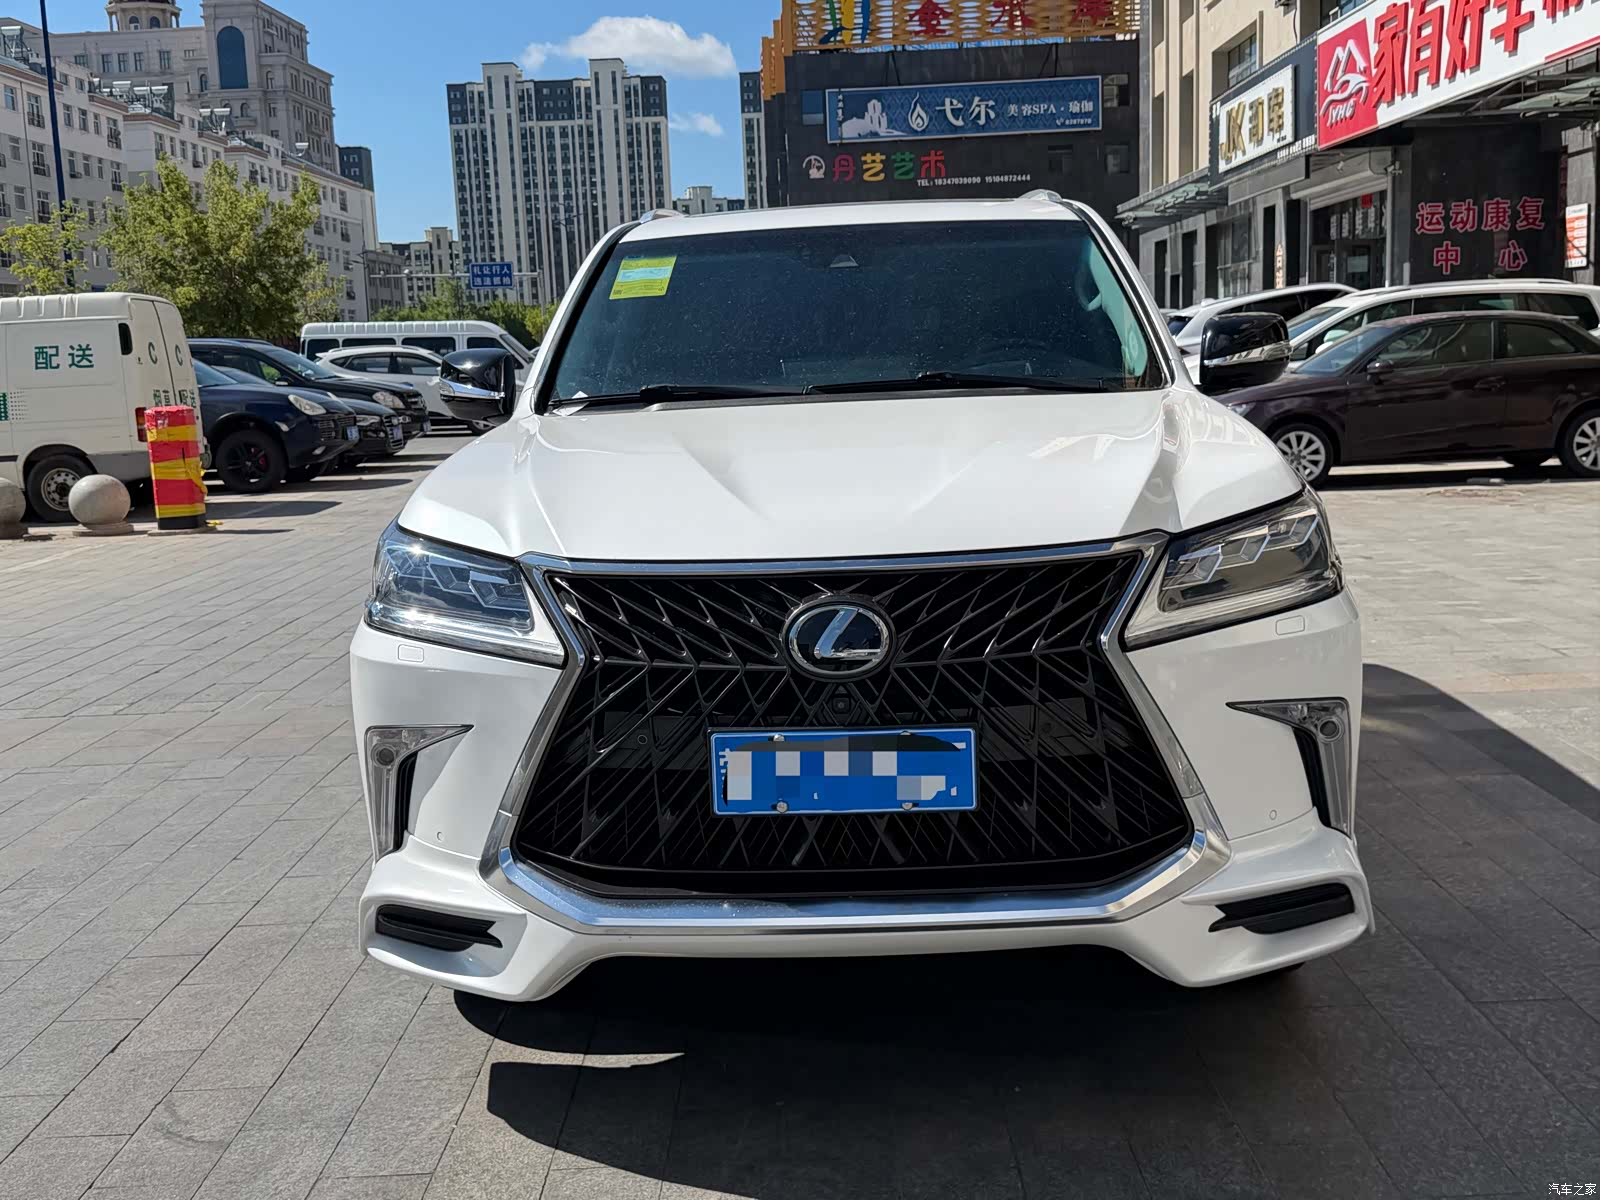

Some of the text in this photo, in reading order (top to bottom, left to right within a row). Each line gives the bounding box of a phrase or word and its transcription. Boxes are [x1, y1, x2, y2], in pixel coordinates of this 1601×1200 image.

[1366, 0, 1584, 106] 家有好车
[832, 149, 946, 182] 丹艺艺术
[1415, 196, 1546, 235] 运动康复
[33, 343, 95, 371] 配送
